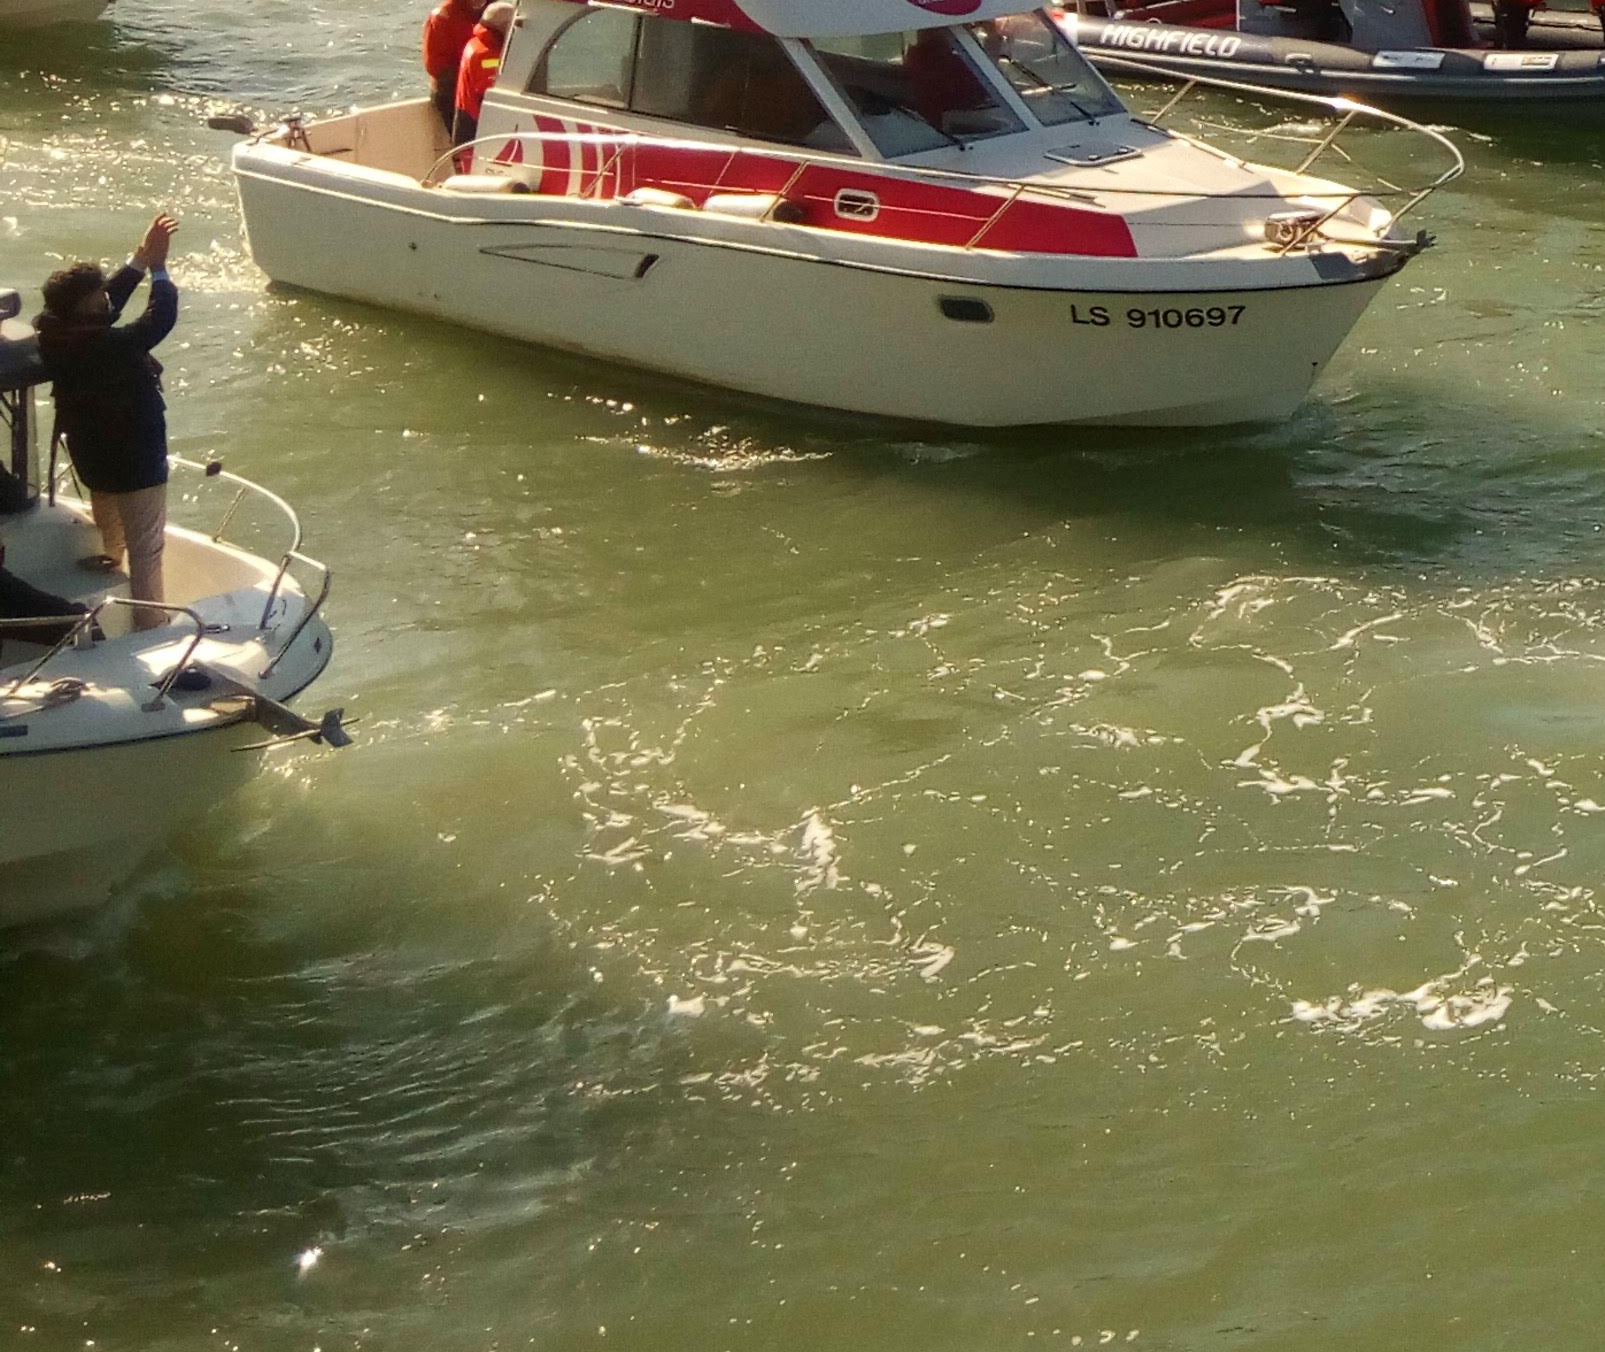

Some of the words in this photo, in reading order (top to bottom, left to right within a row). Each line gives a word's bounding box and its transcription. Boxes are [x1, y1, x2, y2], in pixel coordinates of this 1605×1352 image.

[1100, 24, 1242, 58] HIGHFIELD
[1070, 303, 1111, 327] LS
[1126, 305, 1246, 329] 910697
